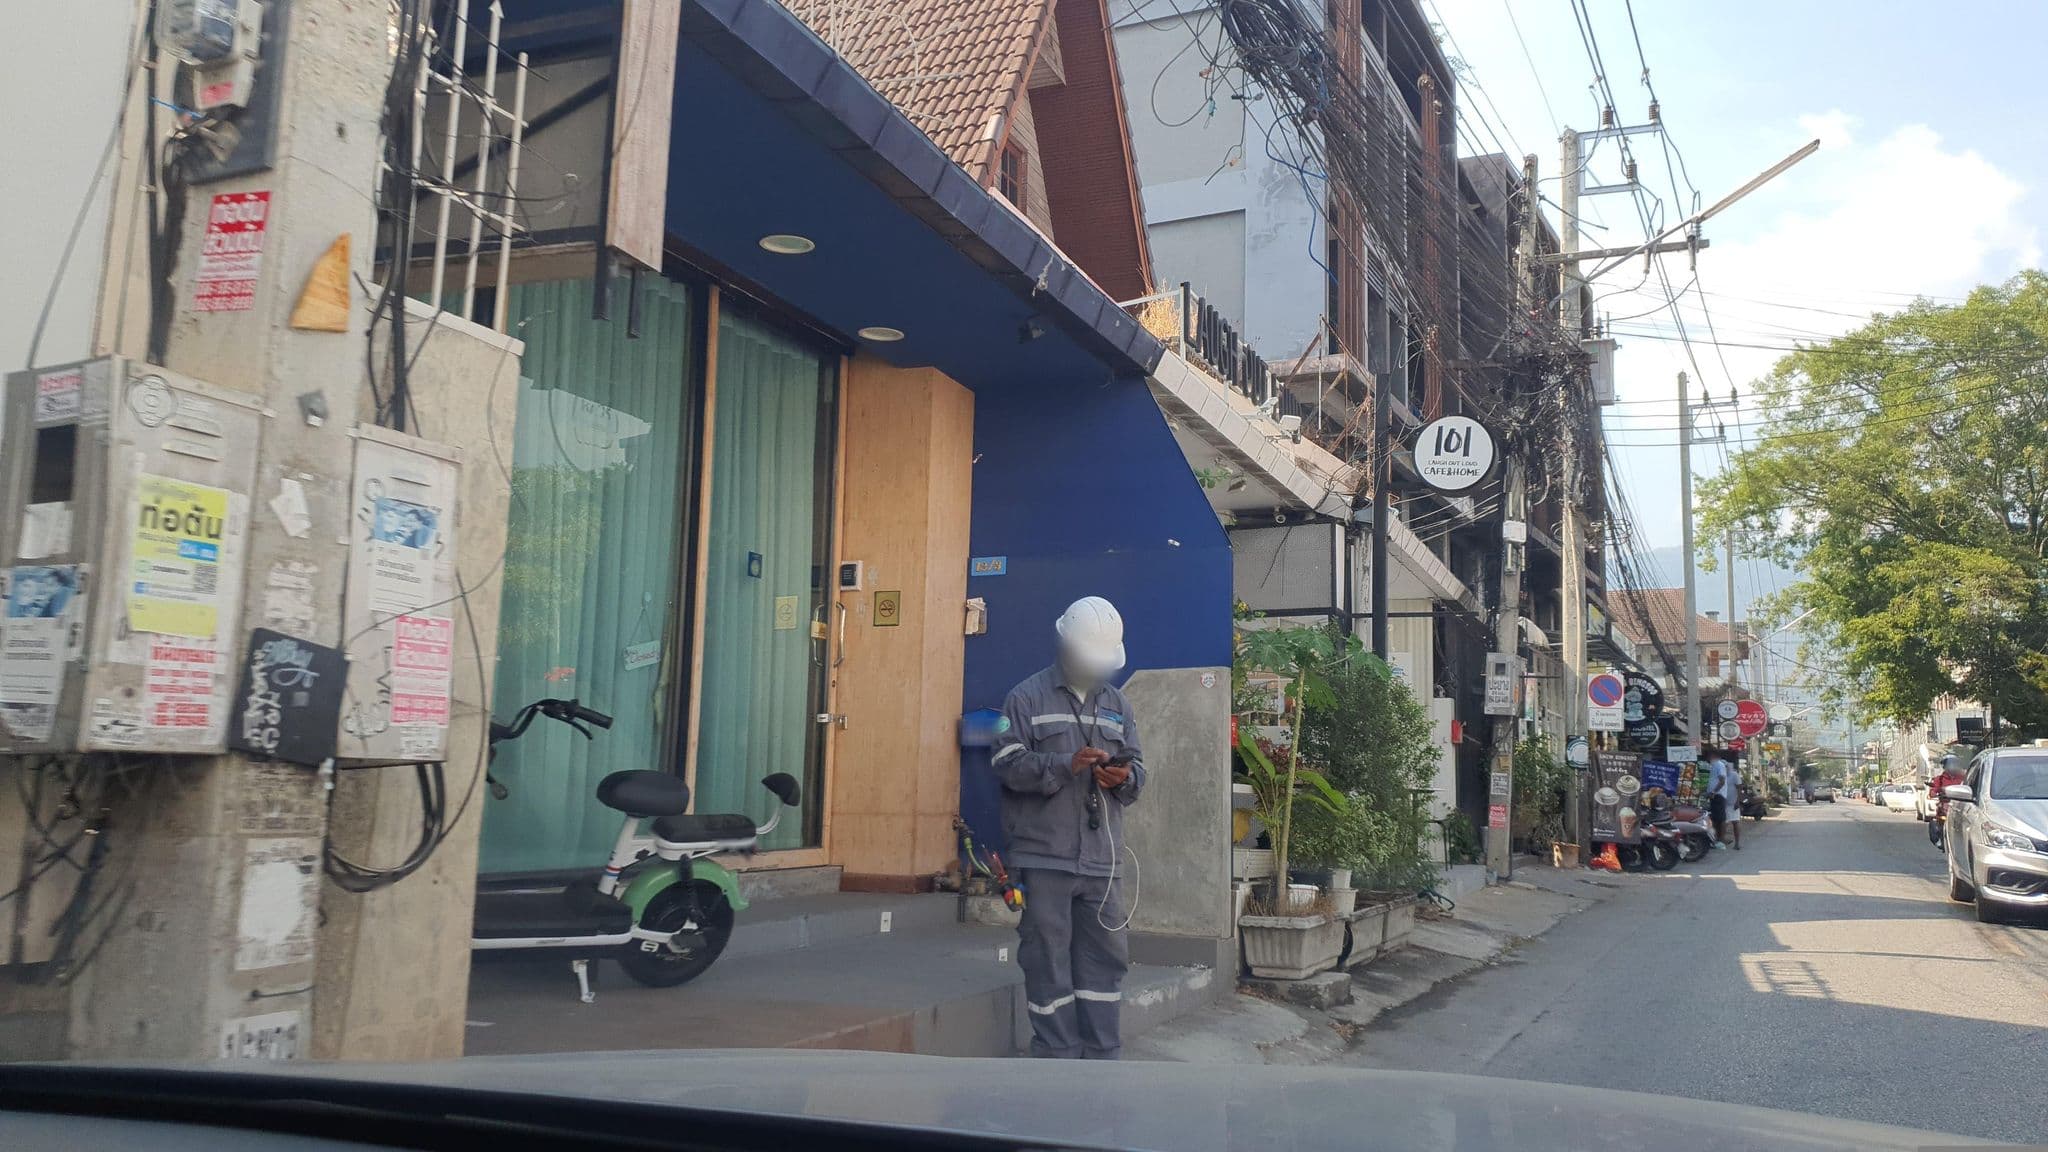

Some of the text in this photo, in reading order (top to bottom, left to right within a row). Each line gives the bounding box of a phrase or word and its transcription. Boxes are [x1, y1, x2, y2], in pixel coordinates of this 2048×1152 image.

[1183, 282, 1238, 387] LAUGH
[139, 497, 222, 540] ท่อตัน
